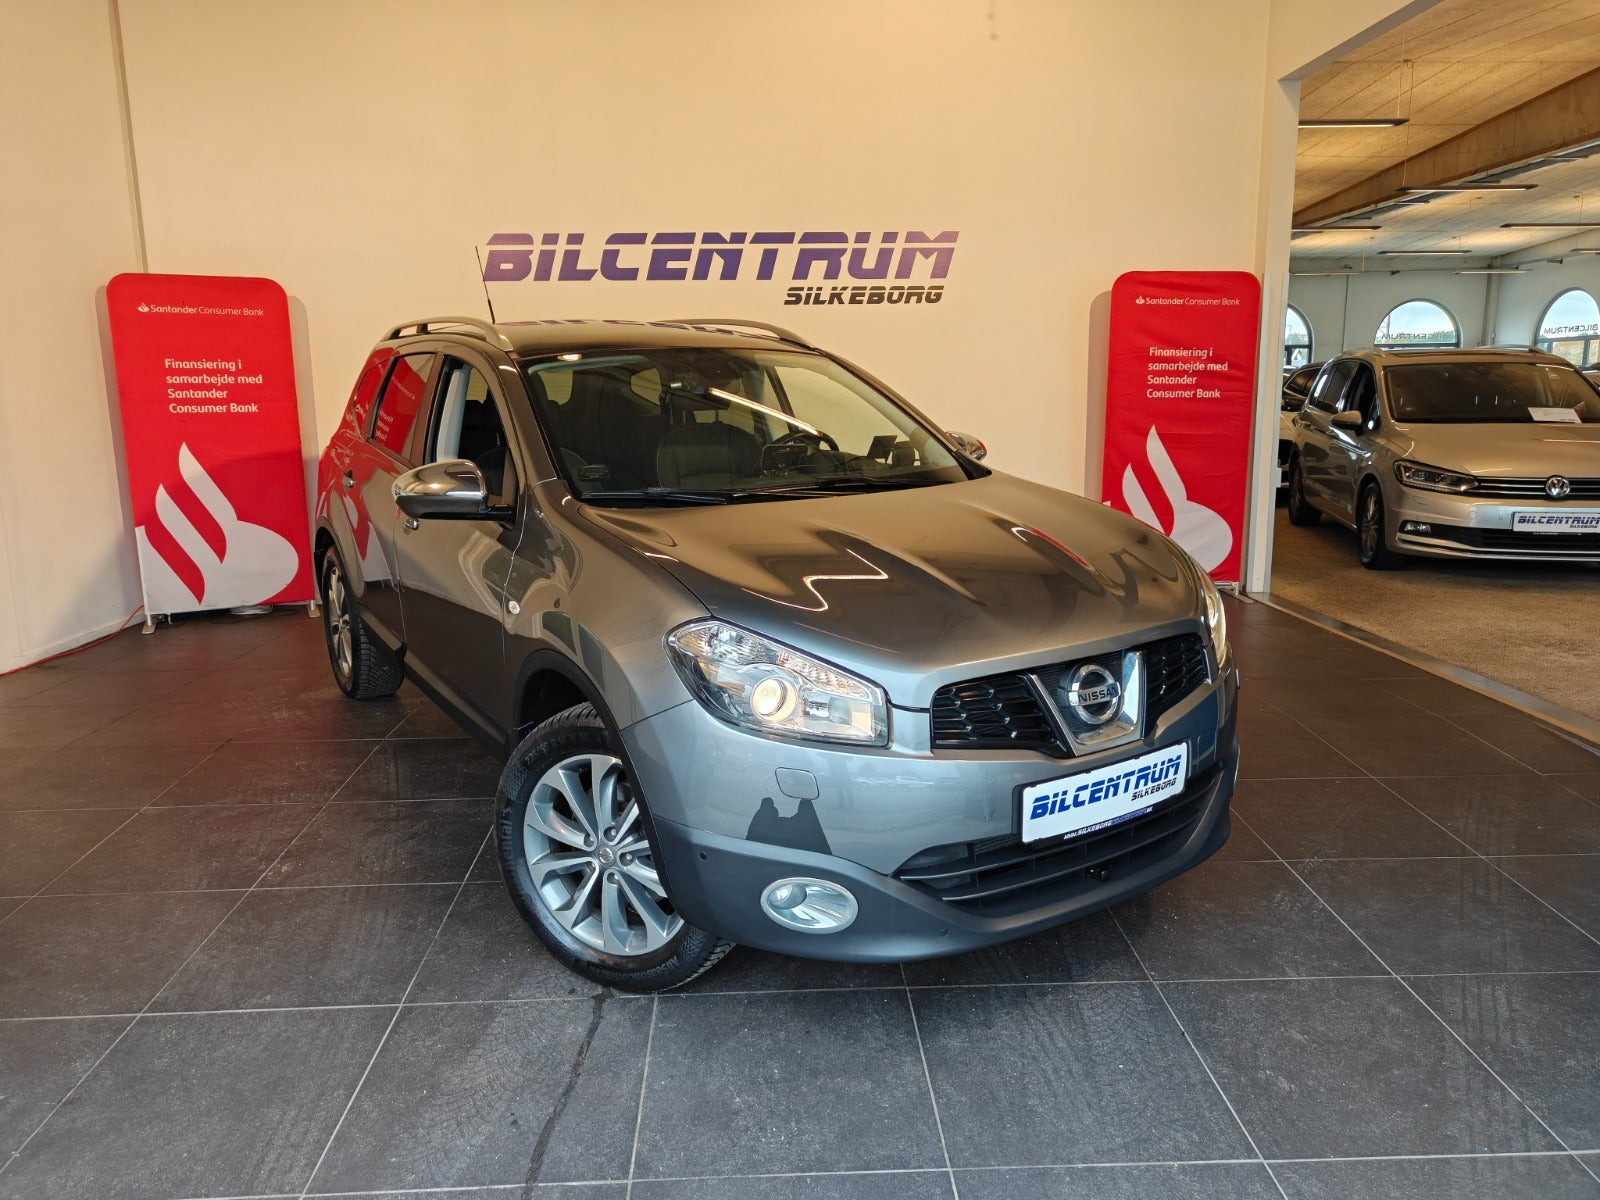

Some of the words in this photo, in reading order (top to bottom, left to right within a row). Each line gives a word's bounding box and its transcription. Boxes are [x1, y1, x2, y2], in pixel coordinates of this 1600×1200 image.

[483, 231, 960, 282] BILCENTRUM
[783, 285, 945, 306] SILKEBORG
[1145, 297, 1184, 305] Santander
[1184, 298, 1222, 306] Consumer
[1221, 298, 1241, 306] Bank
[150, 304, 197, 314] Santander
[198, 306, 242, 316] Consumer
[243, 307, 264, 316] Bank
[1149, 346, 1208, 360] Finansiering
[1209, 347, 1213, 357] i
[164, 358, 236, 372] Finansiering
[237, 359, 242, 370] i
[1147, 361, 1206, 373] samarbejde
[1206, 361, 1229, 371] med
[165, 373, 236, 387] samarbejde
[237, 373, 263, 384] med
[1147, 374, 1198, 385] Santander
[167, 388, 228, 399] Santander
[1146, 388, 1195, 399] Consumer
[1196, 388, 1221, 398] Bank
[168, 402, 228, 414] Consumer
[229, 403, 259, 413] Bank
[1518, 515, 1600, 525] BILCENTRUM
[1079, 686, 1118, 702] NISSAN
[1029, 754, 1183, 821] BILCENTRUM
[1130, 777, 1178, 802] SILKEBORG
